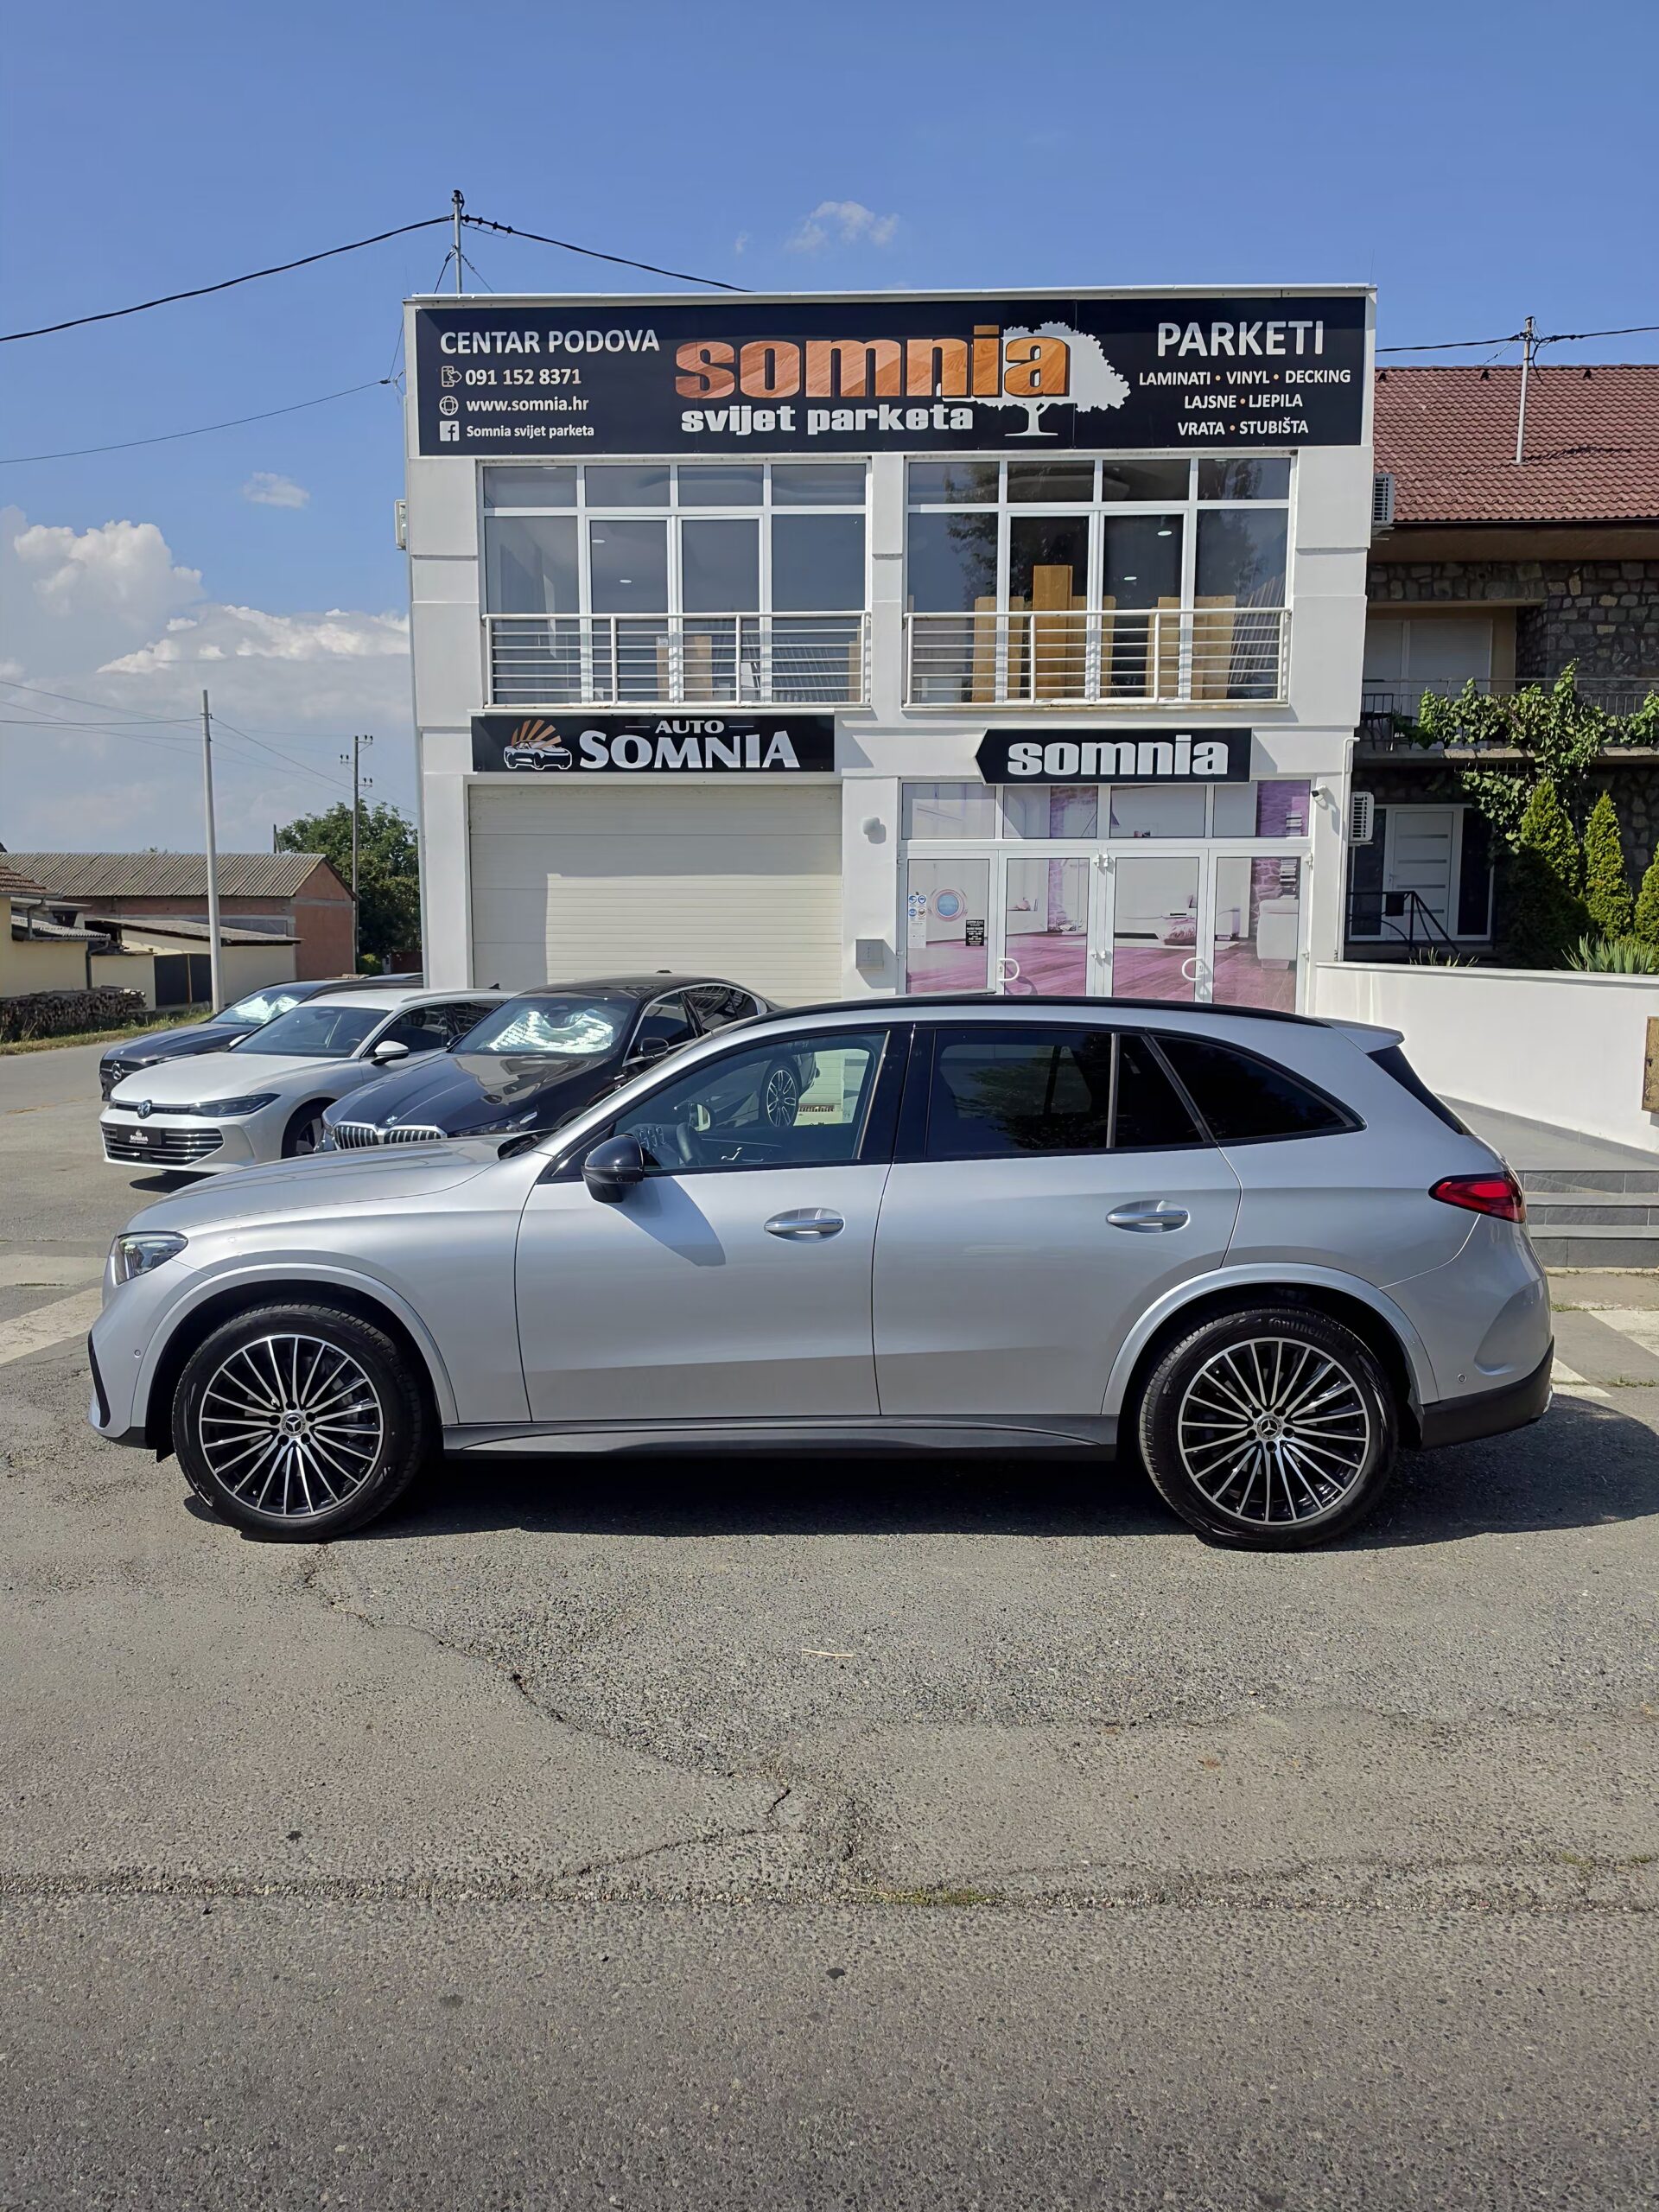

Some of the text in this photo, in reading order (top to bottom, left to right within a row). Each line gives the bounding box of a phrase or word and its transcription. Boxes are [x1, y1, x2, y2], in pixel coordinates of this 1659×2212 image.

[440, 329, 660, 354] CENTAR PODOVA
[1157, 321, 1324, 357] PARKETI
[675, 324, 1070, 398] somnia
[465, 368, 582, 385] 091 152 8371
[1139, 369, 1351, 385] LAMINATI VINYL DECKING
[466, 396, 589, 411] www.somnia.hr
[1184, 393, 1303, 410] LAJSNE LJEPILA
[681, 404, 974, 435] svijet parketa
[1177, 416, 1309, 436] VRATA STUBIŠTA
[467, 424, 594, 439] Somnia svijet parketa
[654, 720, 725, 734] AUTO
[579, 729, 801, 769] SOMNIA
[1007, 734, 1229, 776] somnia
